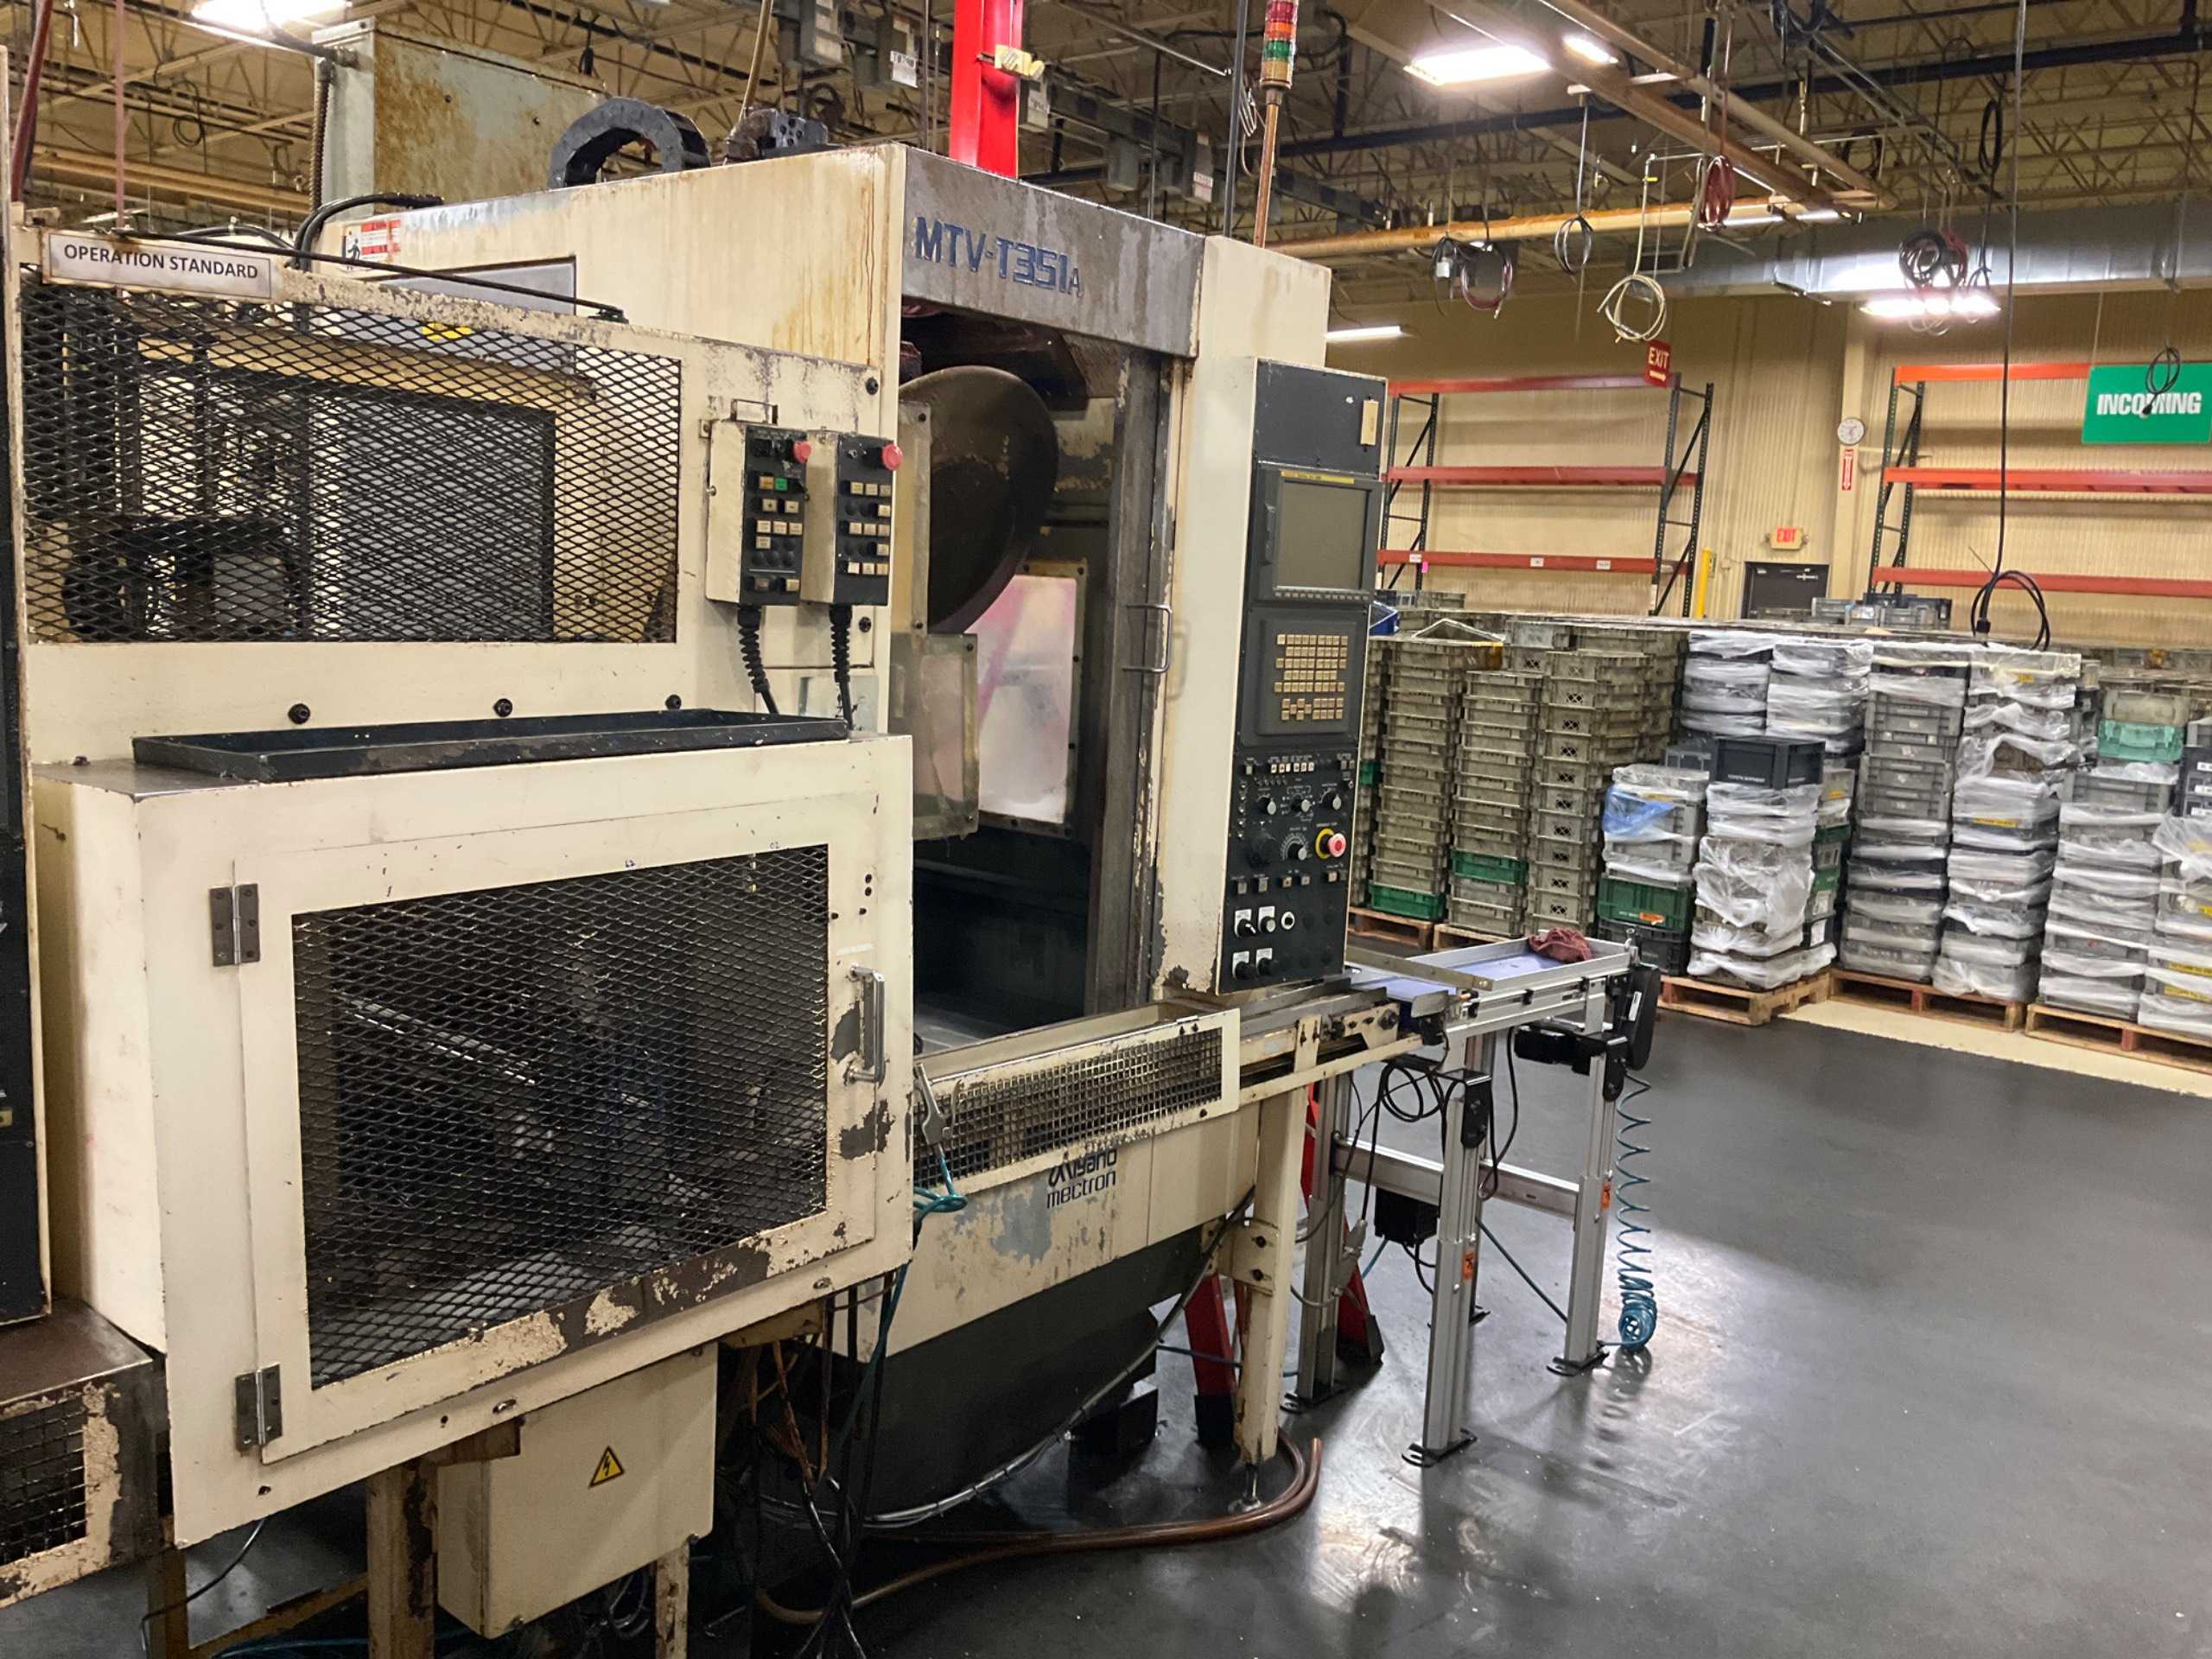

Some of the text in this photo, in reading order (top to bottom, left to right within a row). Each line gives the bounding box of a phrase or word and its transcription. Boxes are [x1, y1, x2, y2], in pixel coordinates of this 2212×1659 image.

[64, 244, 257, 279] OPERATION STANDARD
[1649, 346, 1669, 369] EXIT
[1776, 527, 1797, 543] EXIT
[1046, 1171, 1116, 1209] mectron
